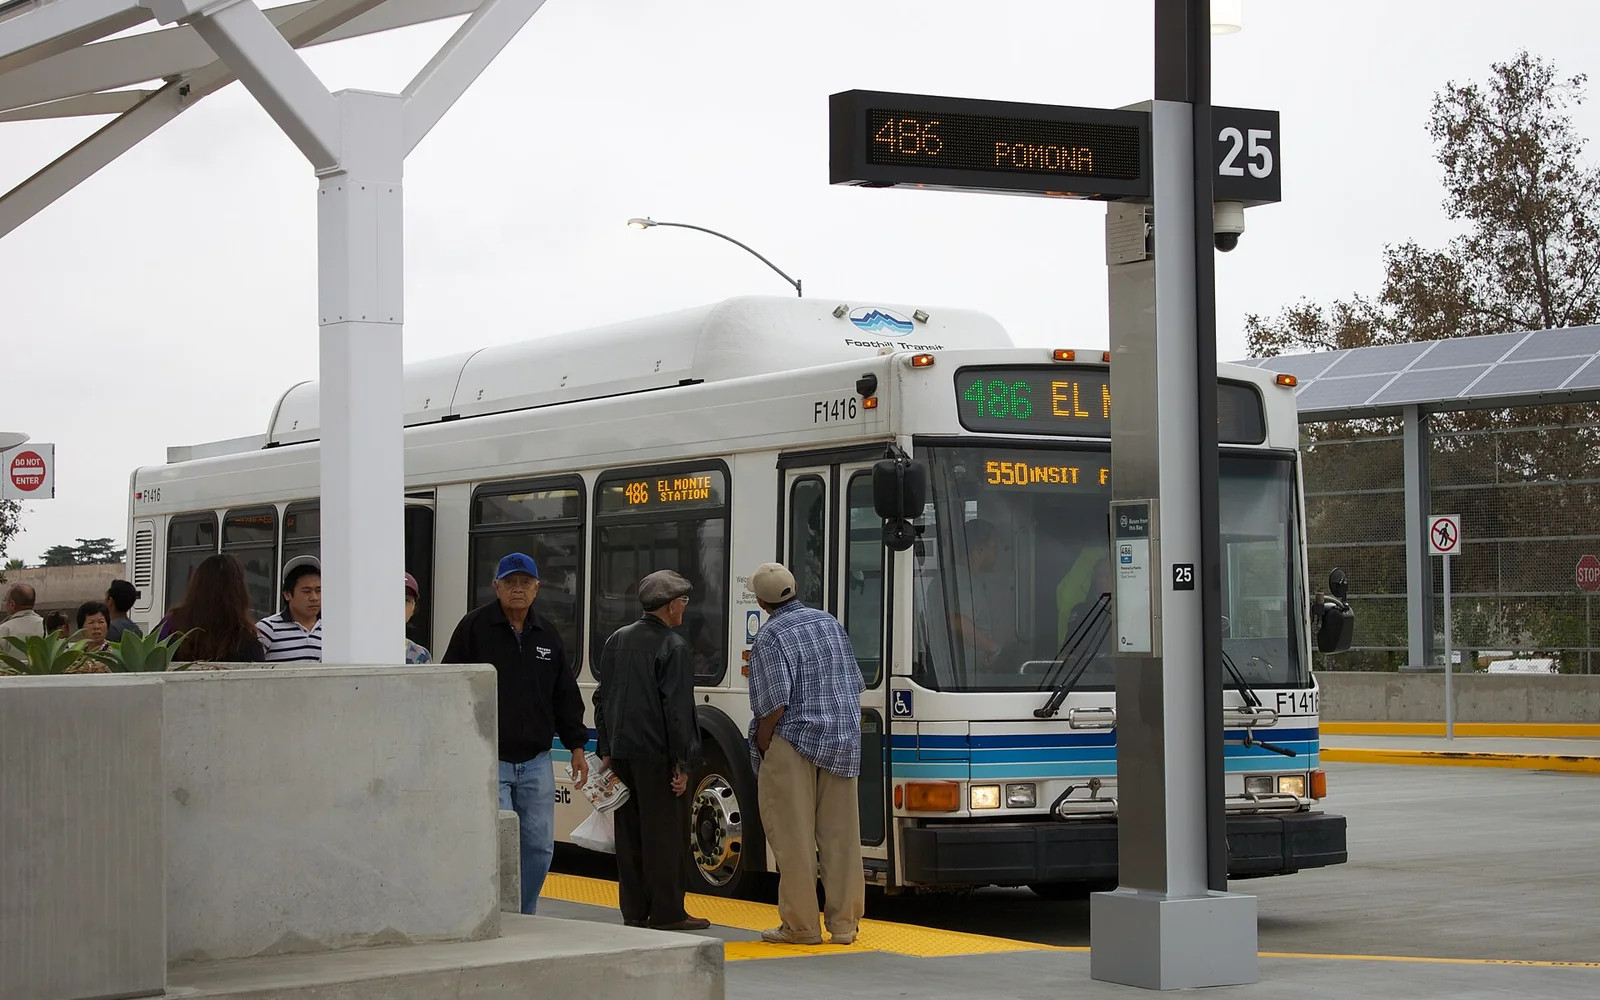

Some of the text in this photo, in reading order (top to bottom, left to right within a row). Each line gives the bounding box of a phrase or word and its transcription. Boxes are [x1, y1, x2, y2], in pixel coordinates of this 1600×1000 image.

[876, 118, 1092, 172] 486 POMONA
[1218, 127, 1273, 179] 25
[844, 338, 895, 349] Foothill
[964, 379, 1033, 419] 486
[1052, 381, 1090, 417] EL
[814, 397, 857, 424] F1416
[15, 458, 41, 467] DO NOT
[15, 476, 40, 485] ENTER
[986, 461, 1028, 486] 550
[143, 487, 161, 503] F1416
[625, 476, 712, 505] 486 EL MONTE
[660, 488, 710, 502] STATION
[1175, 567, 1192, 582] 25
[1578, 567, 1600, 582] STOP
